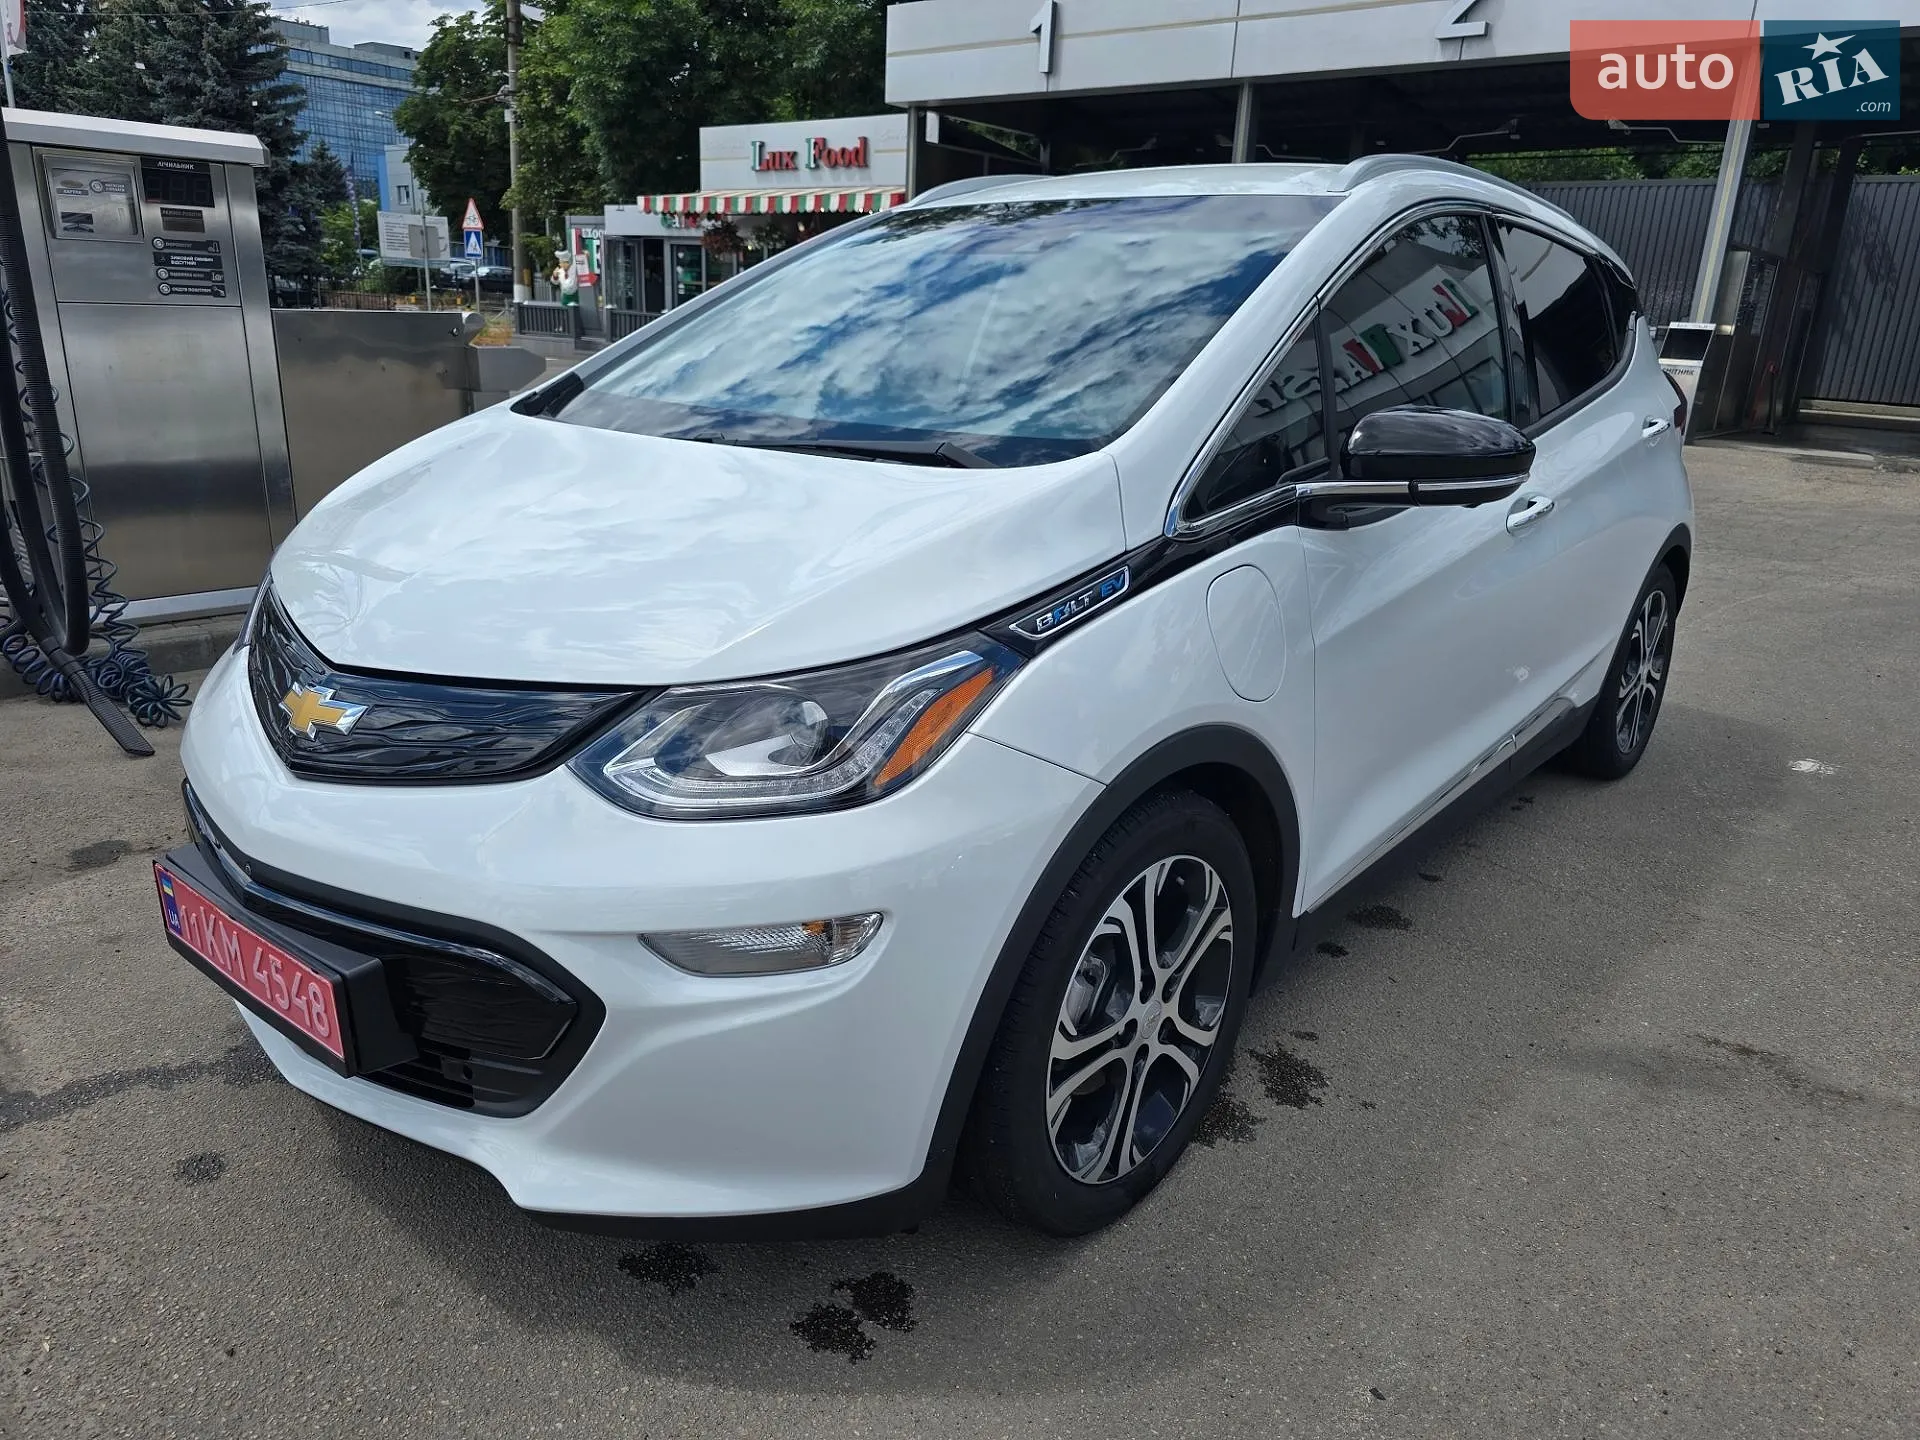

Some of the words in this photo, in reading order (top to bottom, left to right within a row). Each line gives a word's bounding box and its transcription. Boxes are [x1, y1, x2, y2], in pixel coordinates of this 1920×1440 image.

[1029, 0, 1057, 74] 1
[751, 140, 798, 172] Lux
[804, 136, 869, 170] Food
[1100, 573, 1124, 599] EV
[168, 909, 180, 929] UA
[253, 946, 330, 1038] 4548
